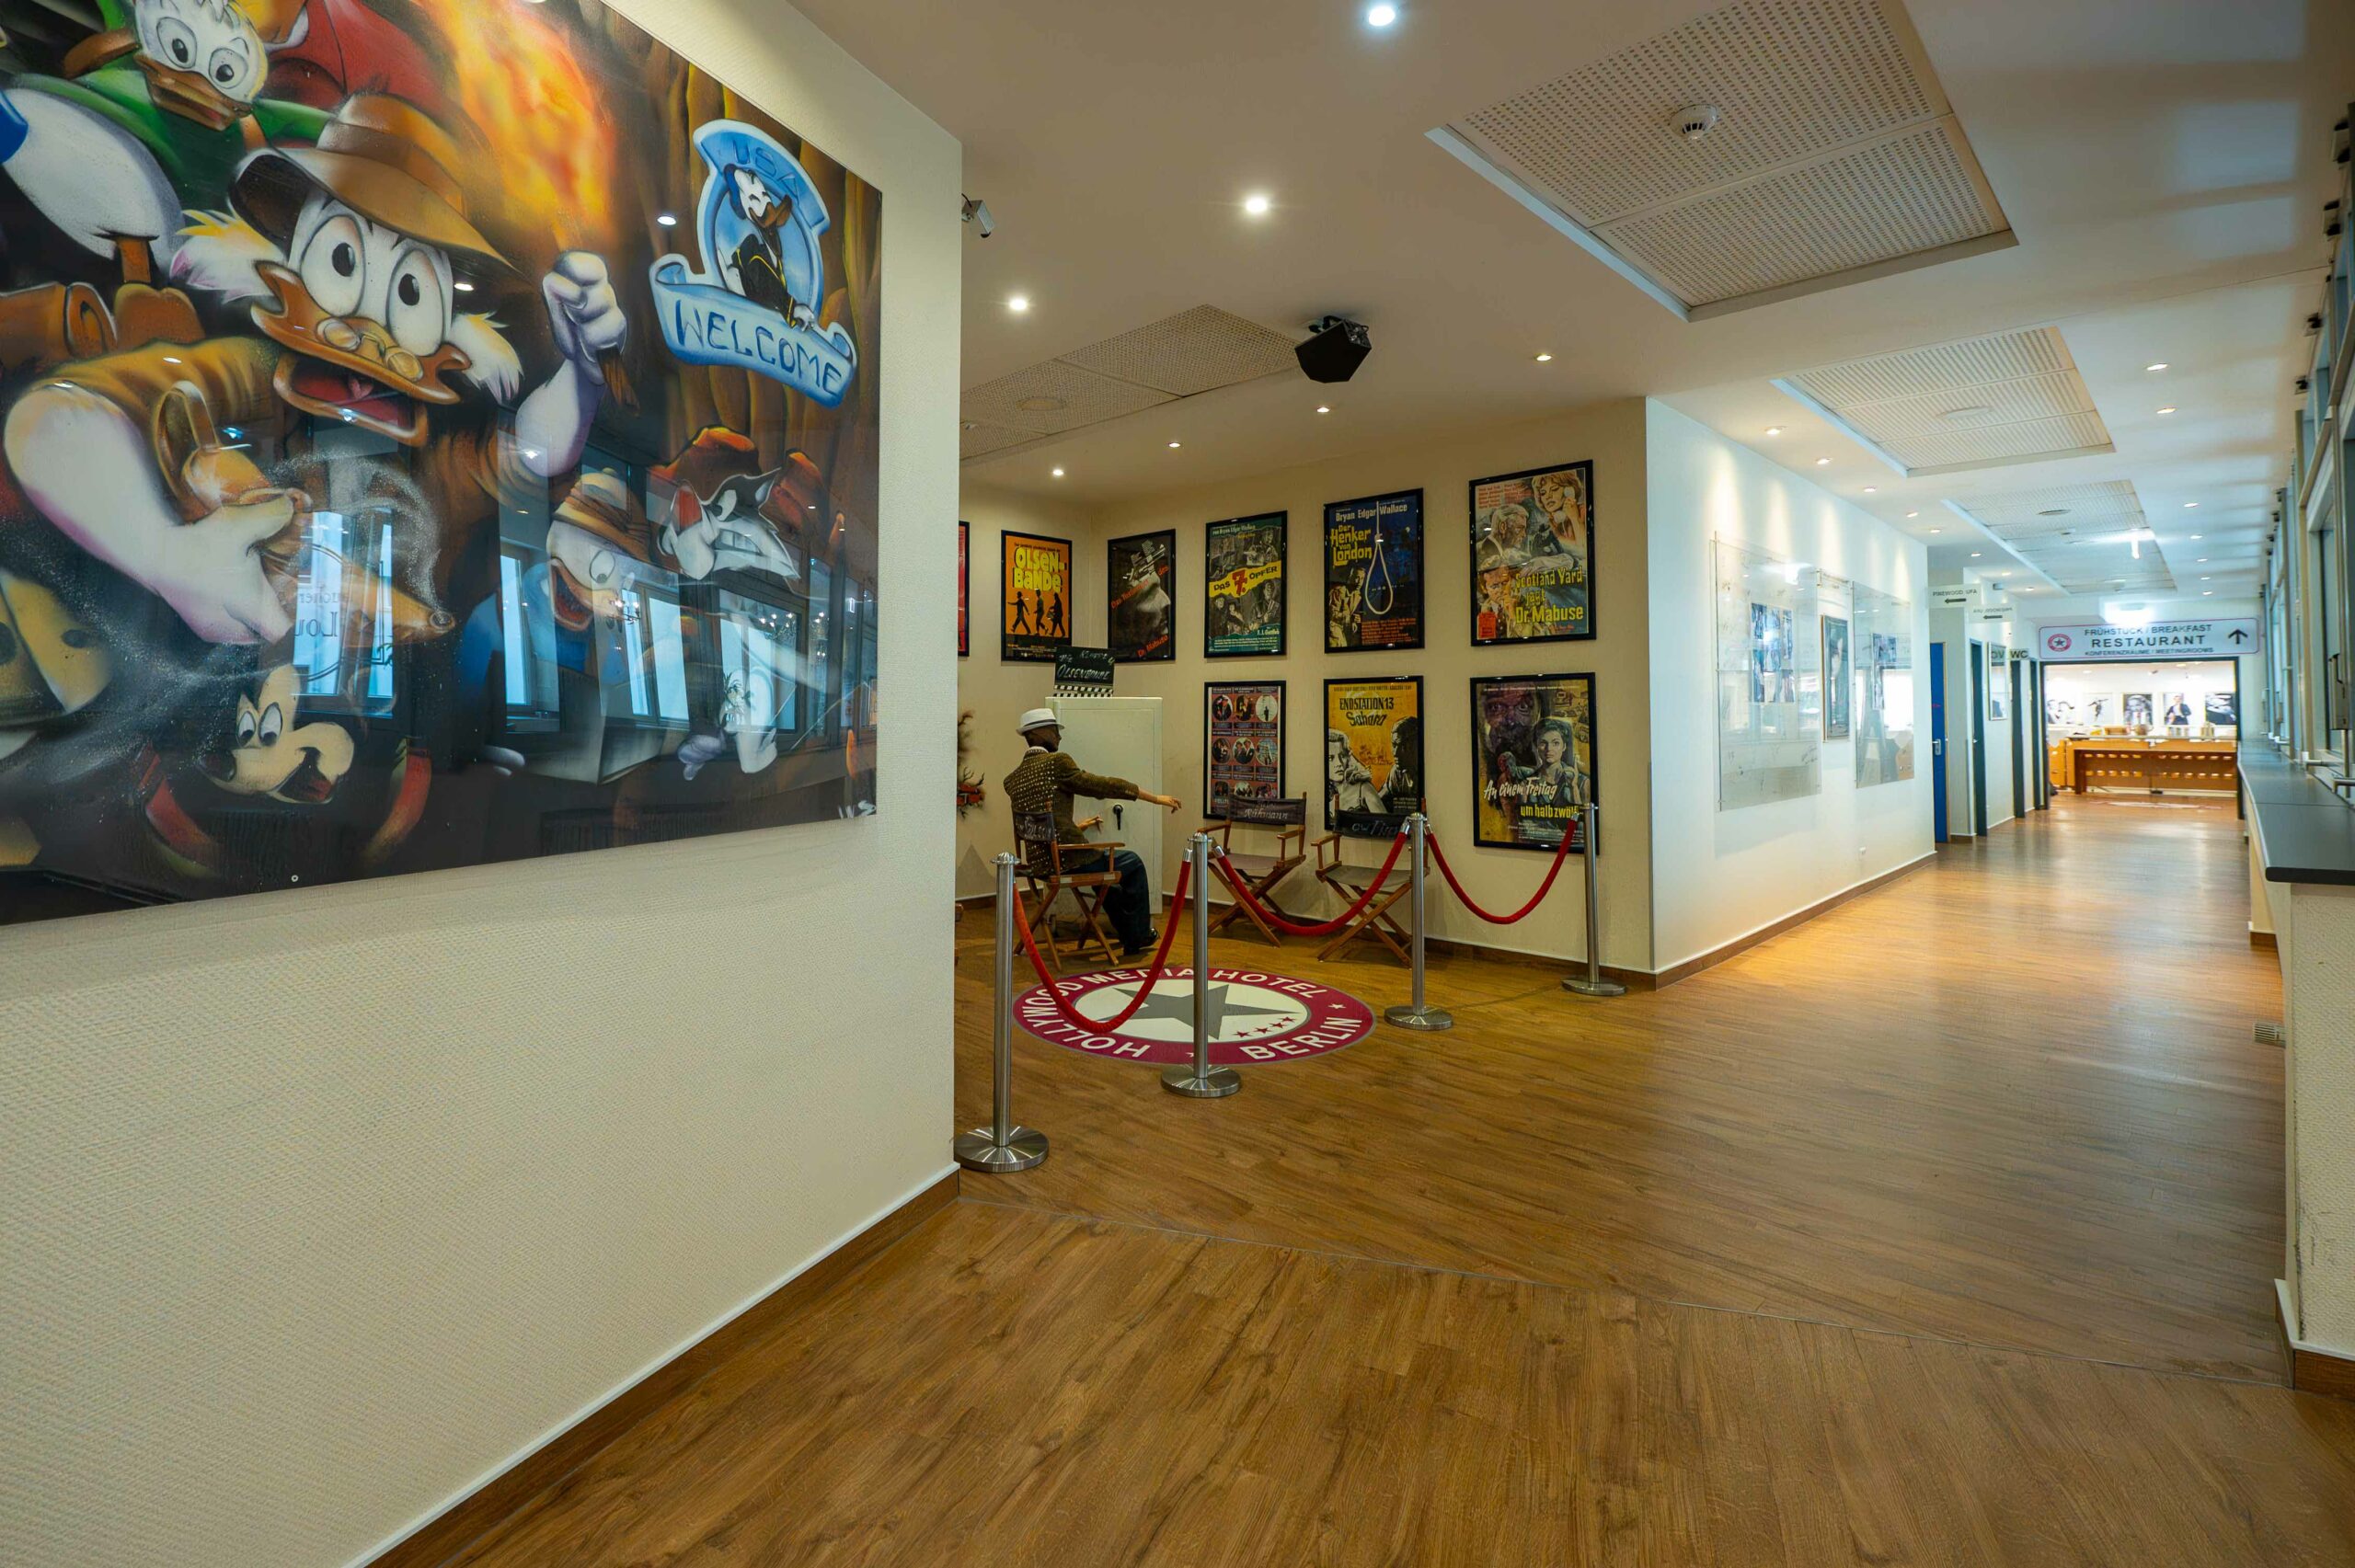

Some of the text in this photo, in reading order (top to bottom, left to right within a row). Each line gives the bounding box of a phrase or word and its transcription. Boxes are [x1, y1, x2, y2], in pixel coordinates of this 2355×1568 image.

[674, 299, 843, 395] WELCOME
[1380, 503, 1407, 515] Wallace
[1330, 526, 1372, 547] Henker
[1332, 542, 1372, 568] London
[1213, 566, 1278, 596] DAS 7. OPFER
[1515, 567, 1583, 591] Scotland Yard
[1525, 589, 1545, 606] jagt
[1516, 605, 1584, 624] Dr. Mabuse
[2151, 624, 2212, 634] BREAKFAST
[2092, 635, 2205, 647] RESTAURANT
[2010, 650, 2028, 658] WC
[1339, 697, 1394, 710] ENDSTATION 13
[1346, 711, 1387, 726] Sahara
[1484, 777, 1557, 800] An einem Freitag
[1520, 806, 1534, 817] um
[1534, 804, 1554, 818] halb
[1213, 970, 1328, 999] HOTEL
[1239, 1016, 1362, 1059] BERLIN
